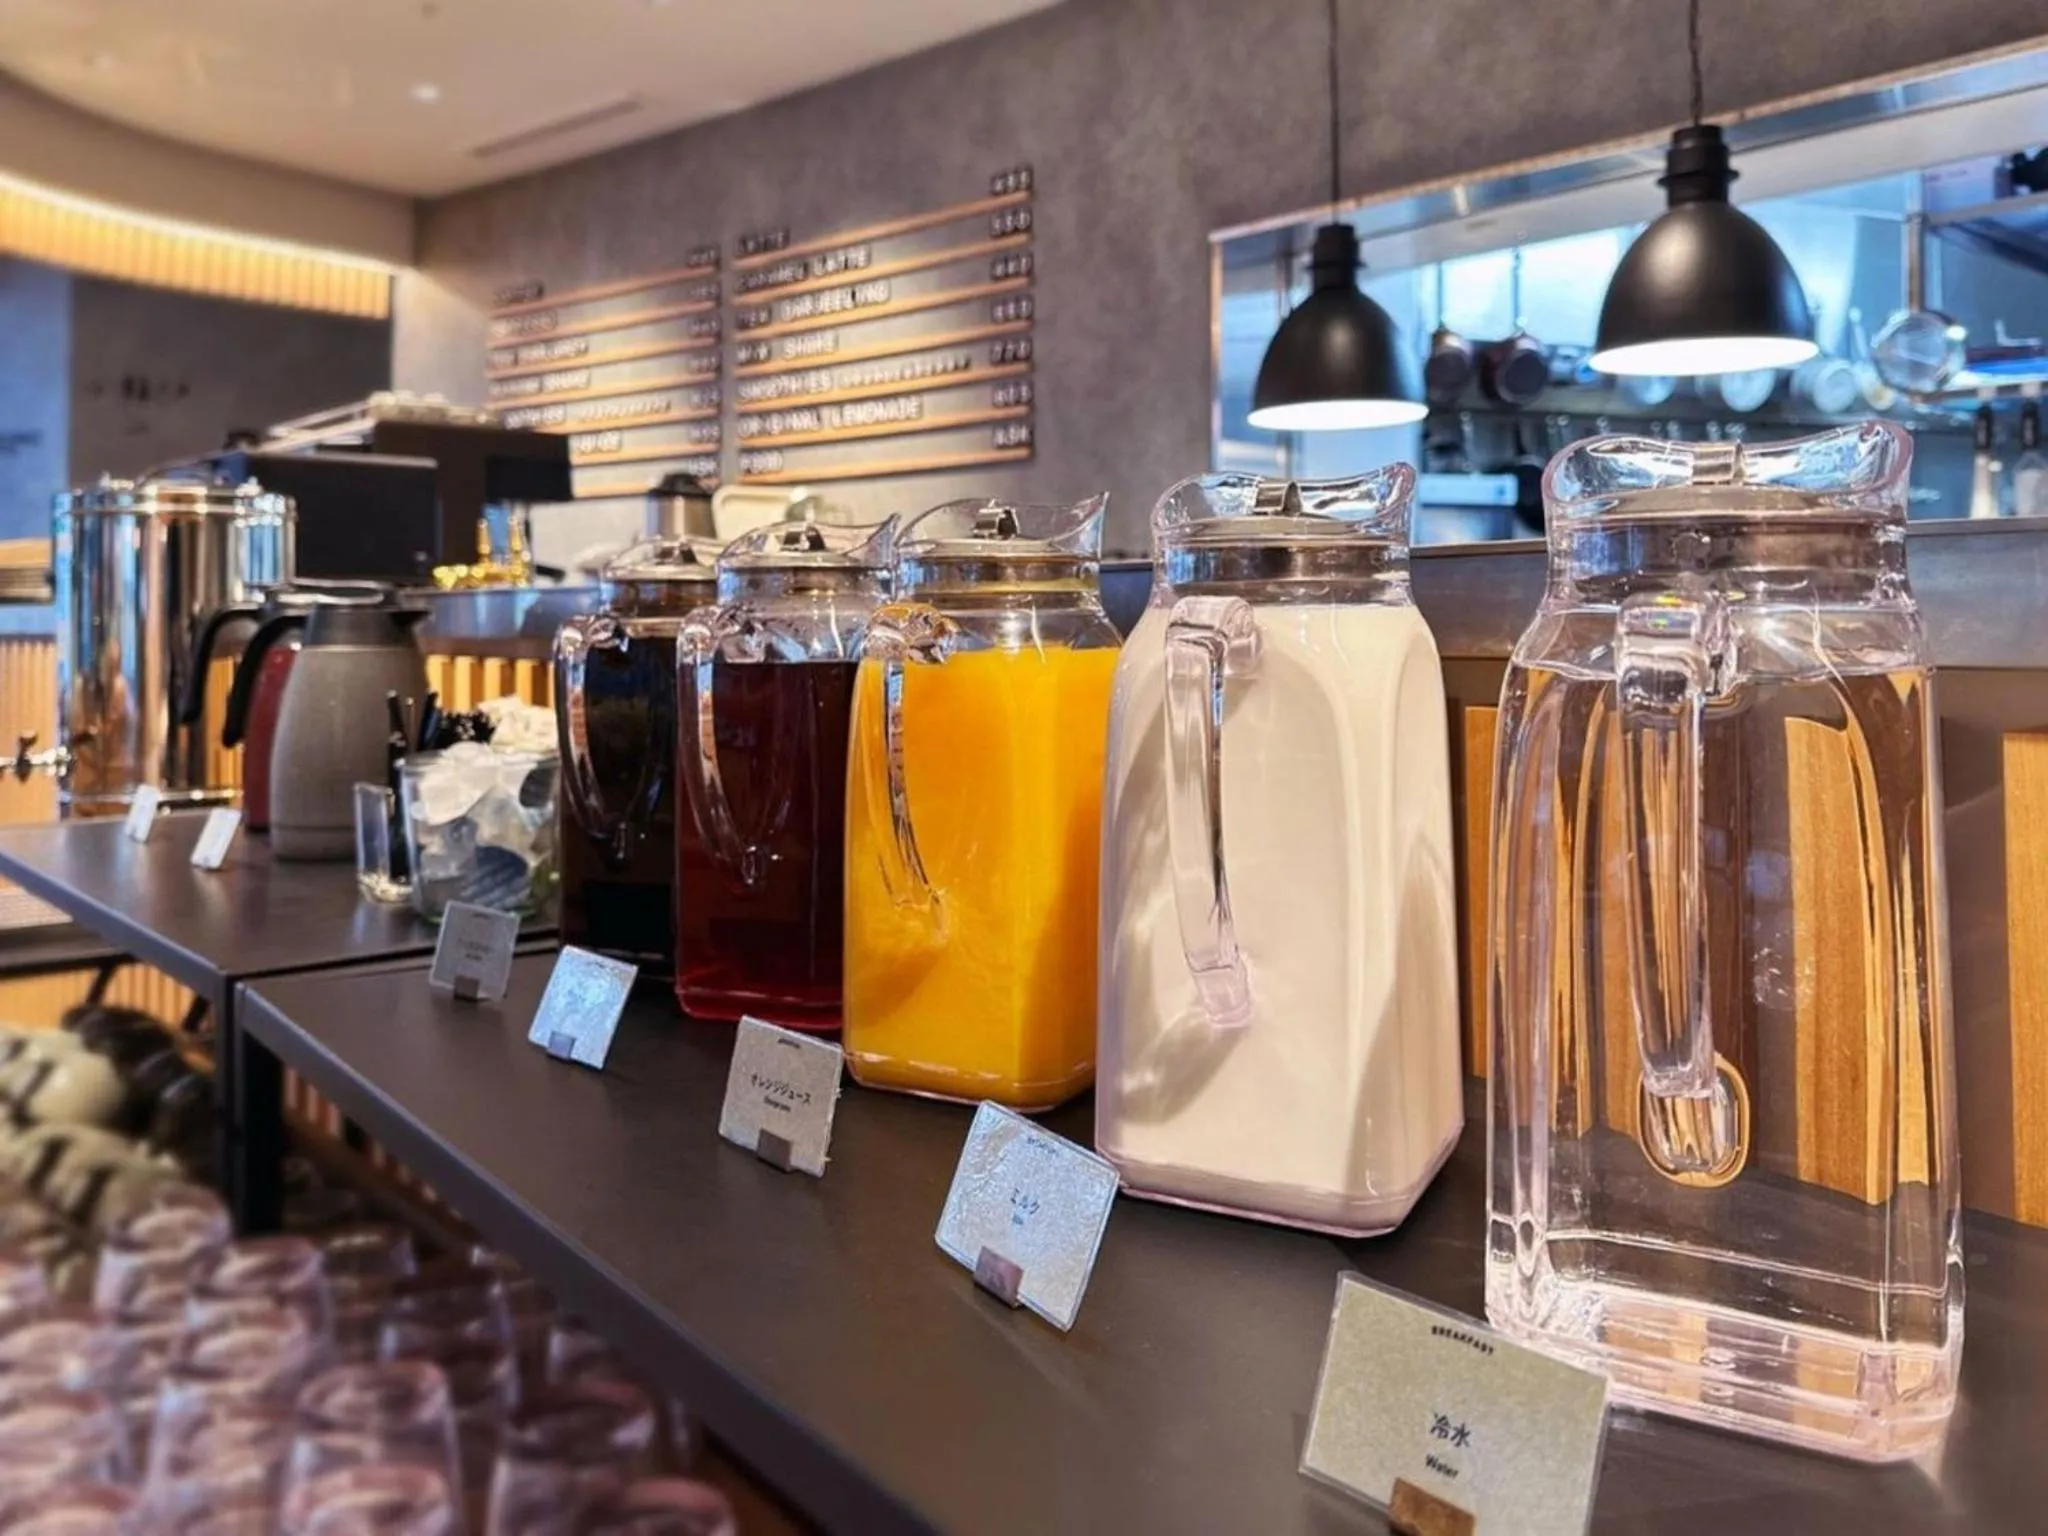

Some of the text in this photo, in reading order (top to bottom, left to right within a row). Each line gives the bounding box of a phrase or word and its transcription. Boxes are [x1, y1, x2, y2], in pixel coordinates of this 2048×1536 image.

[1431, 1325, 1495, 1356] BREAKFAST
[1428, 1412, 1473, 1448] 冷水
[1424, 1455, 1460, 1480] Water
